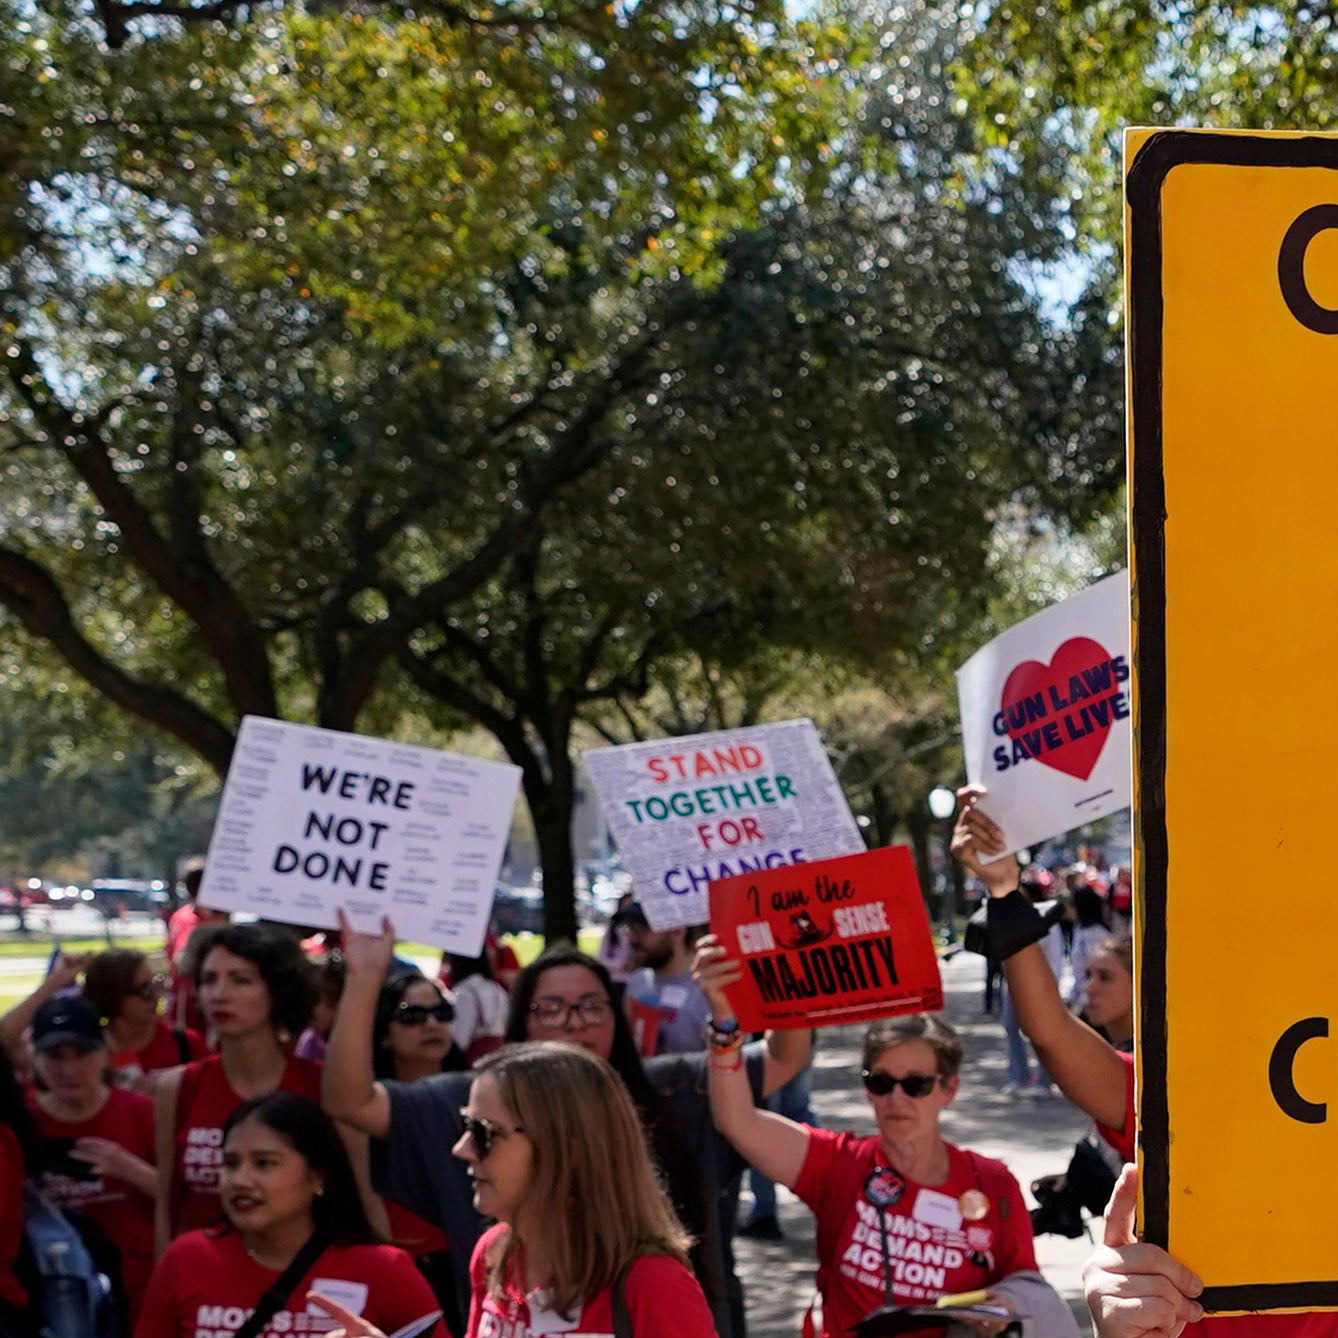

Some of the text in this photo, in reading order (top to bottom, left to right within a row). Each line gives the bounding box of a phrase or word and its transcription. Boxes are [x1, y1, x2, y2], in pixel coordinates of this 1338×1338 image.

[993, 655, 1129, 737] GUN LAWS
[993, 690, 1130, 772] SAVE LIVE
[302, 763, 417, 810] WE'RE
[646, 745, 763, 784] STAND
[626, 775, 798, 824] TOGETHER
[304, 811, 389, 850] NOT
[697, 817, 764, 851] FOR
[273, 845, 390, 891] DONE
[747, 876, 856, 917] I am the
[736, 901, 892, 955] GUN SENSE
[747, 937, 900, 1004] MAJORITY
